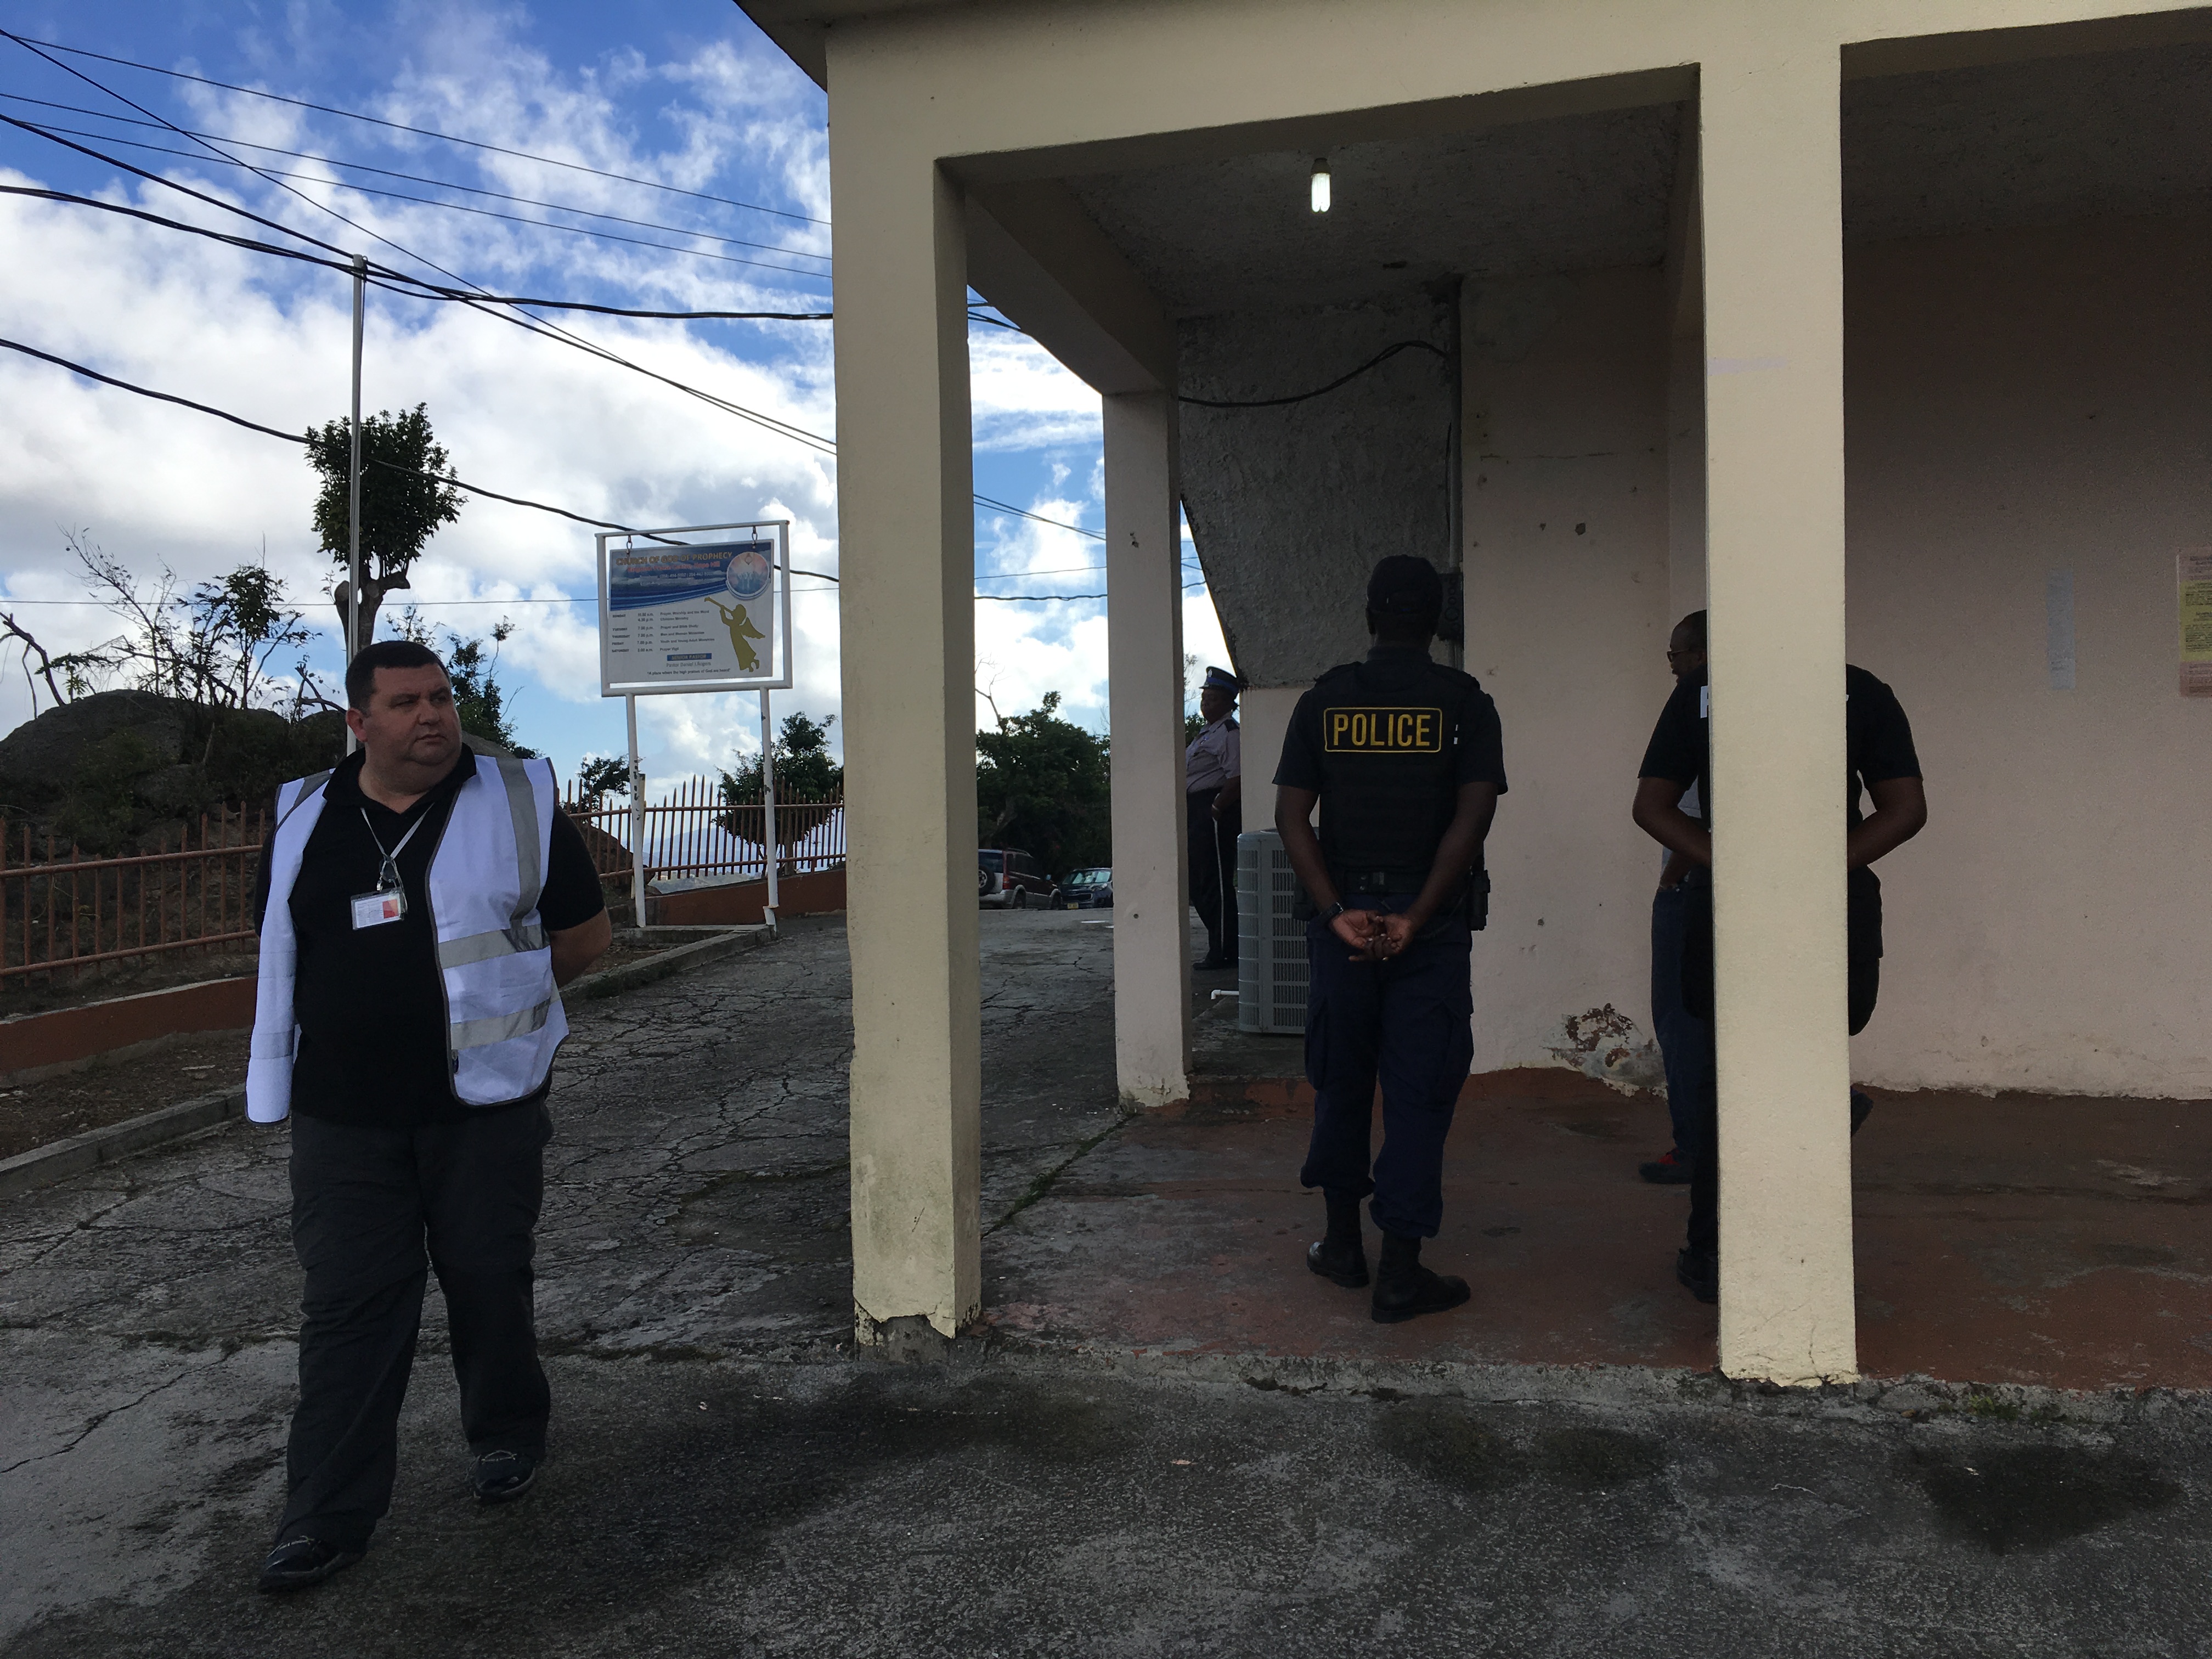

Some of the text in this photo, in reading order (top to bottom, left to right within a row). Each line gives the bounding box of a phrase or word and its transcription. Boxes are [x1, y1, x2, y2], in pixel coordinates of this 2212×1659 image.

[616, 556, 647, 565] CHURCH
[692, 551, 732, 560] PROPHECY
[1333, 714, 1431, 747] POLICE
